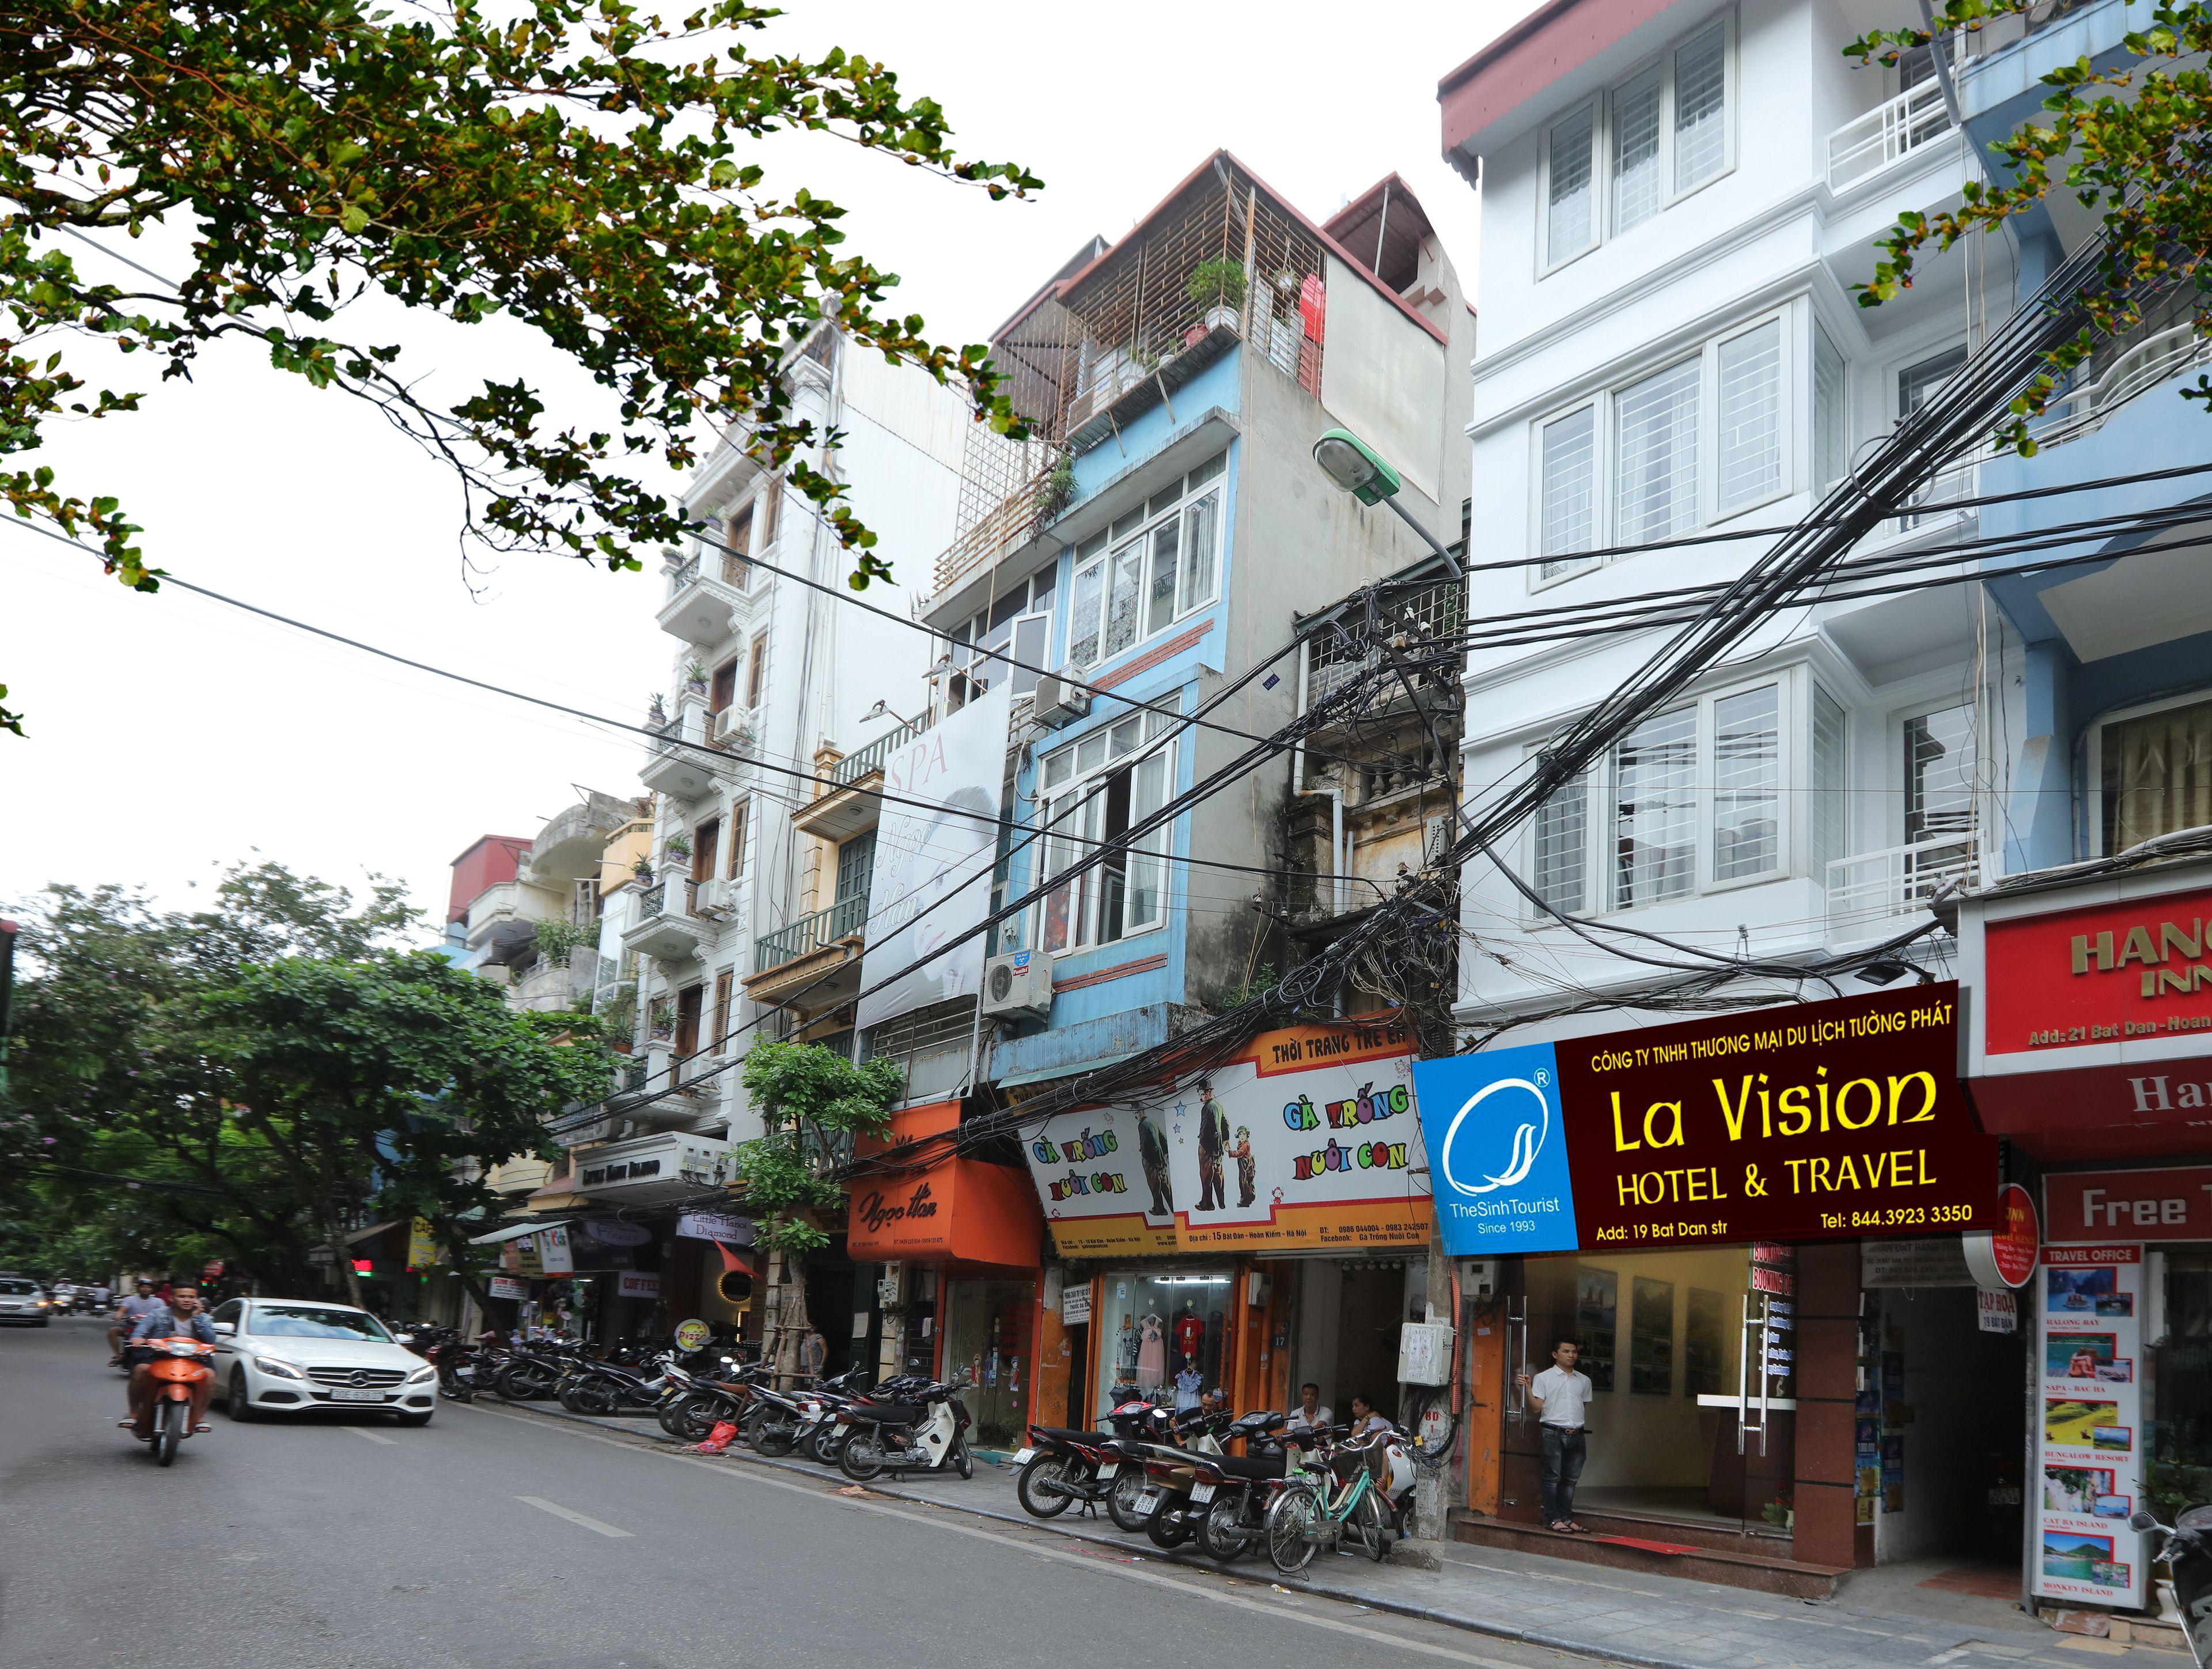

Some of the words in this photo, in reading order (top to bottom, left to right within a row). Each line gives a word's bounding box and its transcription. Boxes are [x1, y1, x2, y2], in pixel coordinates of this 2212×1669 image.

[887, 732, 949, 804] SPA
[2071, 917, 2212, 975] HAN
[2141, 964, 2212, 997] INN
[1592, 1050, 1633, 1072] CÔNG
[1635, 1048, 1650, 1066] TY
[1653, 1043, 1688, 1064] TNHH
[1691, 1035, 1750, 1059] THƯƠNG
[1755, 1029, 1782, 1053] MẠI
[1787, 1025, 1806, 1046] DU
[1812, 1019, 1844, 1046] LỊCH
[1849, 1010, 1906, 1037] TƯỜNG
[1911, 1000, 1952, 1028] PHÁT
[2091, 1023, 2119, 1039] Bat
[2125, 1020, 2157, 1035] Dan
[2168, 1015, 2211, 1031] Hoan
[1272, 1038, 1302, 1064] THỜI
[1305, 1034, 1350, 1059] TRANG
[1283, 1093, 1320, 1132] GÀ
[1325, 1081, 1410, 1130] TRỐNG
[1610, 1091, 1685, 1152] La
[1713, 1065, 1938, 1142] Vision
[1032, 1135, 1060, 1165] GÀ
[1060, 1126, 1118, 1164] TRỐNG
[1292, 1138, 1352, 1181] NUÔI
[1357, 1139, 1409, 1171] CON
[1048, 1169, 1090, 1202] NUÔI
[1090, 1171, 1128, 1194] CON
[1617, 1167, 1728, 1207] HOTEL
[1745, 1163, 1769, 1197] &
[1785, 1149, 1937, 1195] TRAVEL
[858, 1191, 905, 1233] Ngọc
[1820, 1213, 1846, 1228] Tel:
[1851, 1208, 1925, 1227] 844.3923
[1930, 1205, 1972, 1223] 3350
[2083, 1188, 2187, 1227] Free
[696, 1224, 737, 1239] Diamond
[1213, 1232, 1221, 1240] 15
[1296, 1229, 1306, 1238] Nội
[1321, 1234, 1352, 1242] Facebook:
[1359, 1233, 1368, 1241] Gà
[1369, 1232, 1387, 1242] Trống
[1389, 1232, 1404, 1240] Nuôi
[1407, 1231, 1419, 1239] Con
[1404, 1223, 1428, 1231] 242507
[1478, 1223, 1506, 1234] Since
[1510, 1220, 1536, 1232] 1993
[1596, 1226, 1628, 1241] Add:
[1634, 1225, 1646, 1239] 19
[1652, 1223, 1675, 1237] Bat
[1678, 1222, 1707, 1236] Dan
[1711, 1220, 1728, 1234] str
[2049, 1250, 2089, 1262] TRAVEL
[2092, 1250, 2132, 1261] OFFICE
[1752, 1267, 1783, 1295] BOOKING
[1275, 1337, 1285, 1346] 17
[2045, 1451, 2091, 1459] BUNGALOW
[2095, 1454, 2130, 1462] RESORT
[1135, 1504, 1150, 1512] 9538
[2077, 1520, 2108, 1529] ISLAND
[2043, 1581, 2079, 1592] MONKEY
[2081, 1587, 2114, 1597] ISLAND
